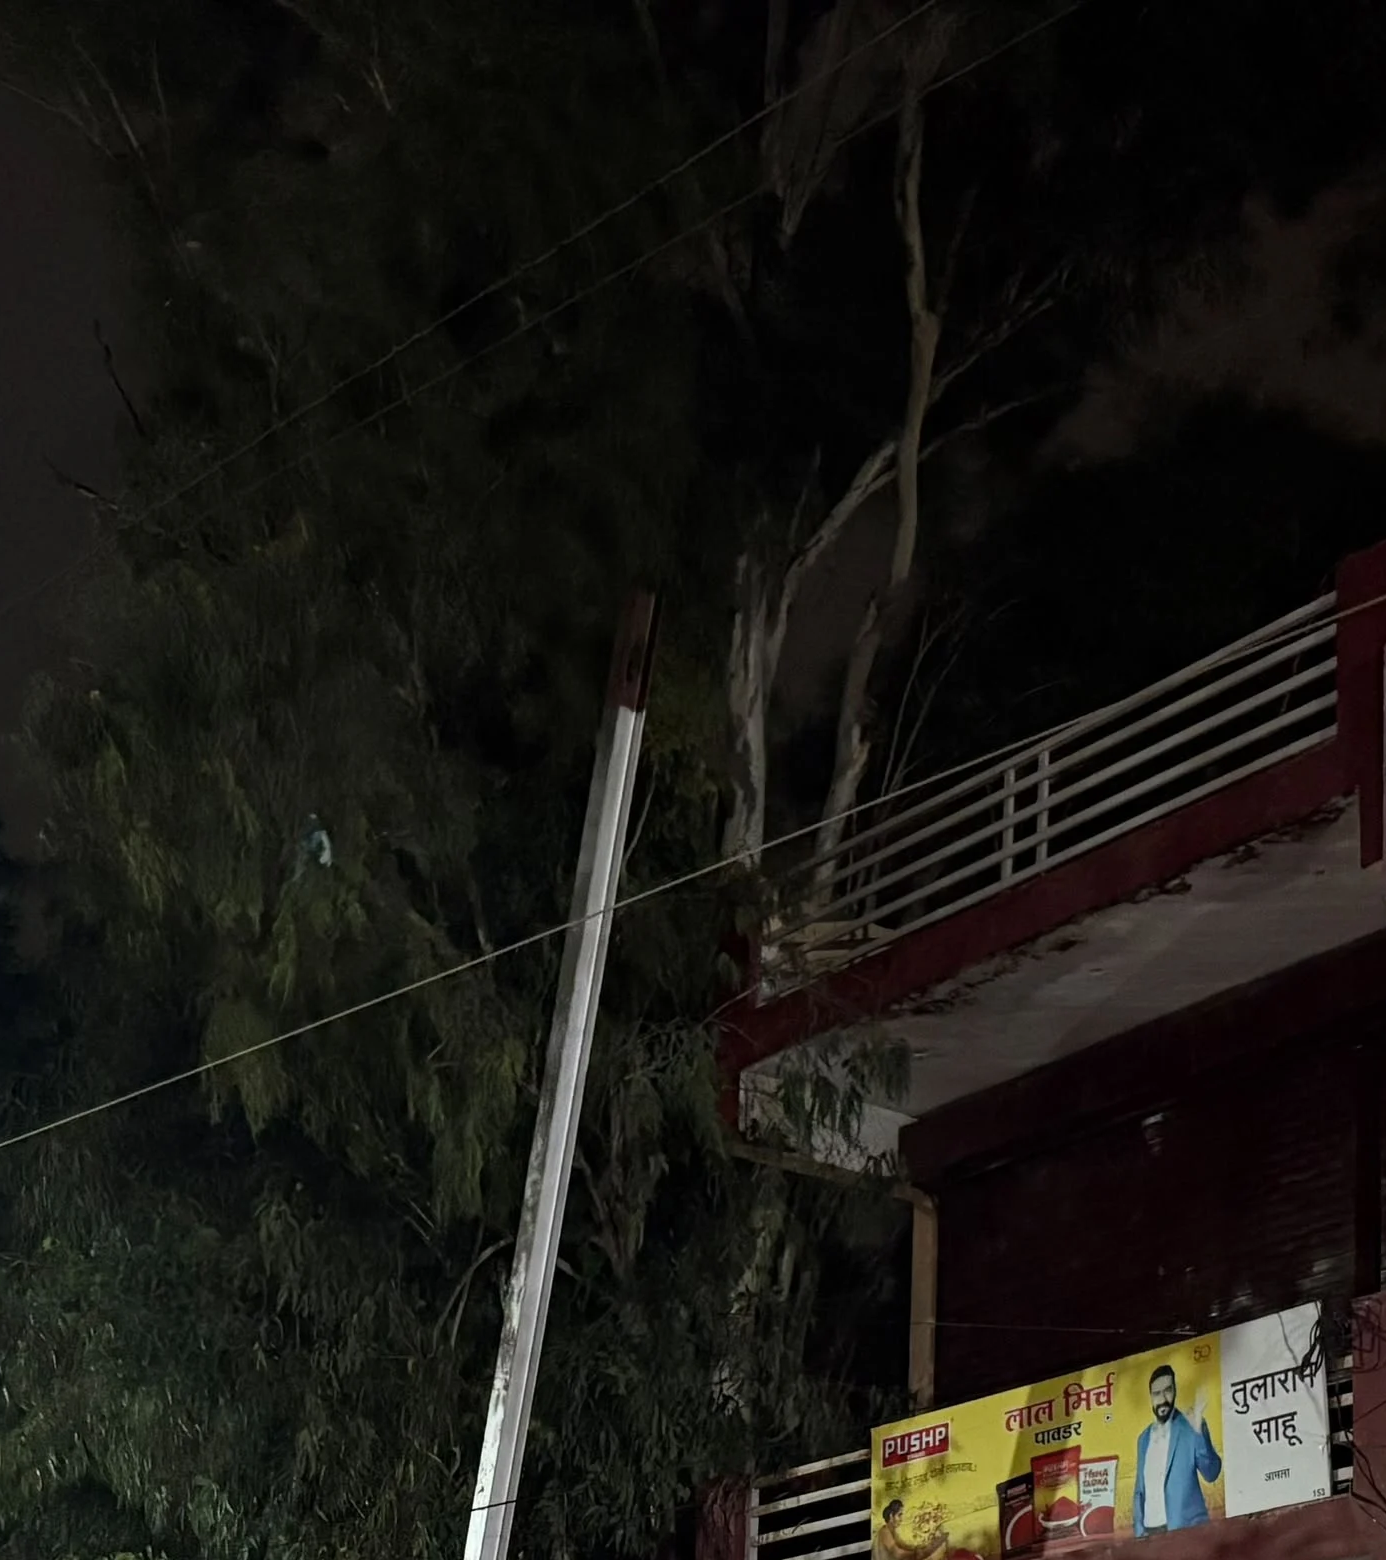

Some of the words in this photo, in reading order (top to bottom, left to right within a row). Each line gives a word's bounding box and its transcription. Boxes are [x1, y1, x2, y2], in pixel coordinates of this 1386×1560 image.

[1005, 1398, 1055, 1432] लाल
[1063, 1372, 1115, 1417] मिर्च
[1231, 1362, 1316, 1414] तुलाराम
[885, 1426, 946, 1458] PUSHP
[1034, 1421, 1082, 1445] पावडर
[1252, 1411, 1303, 1446] साहू
[1313, 1488, 1326, 1497] 153
